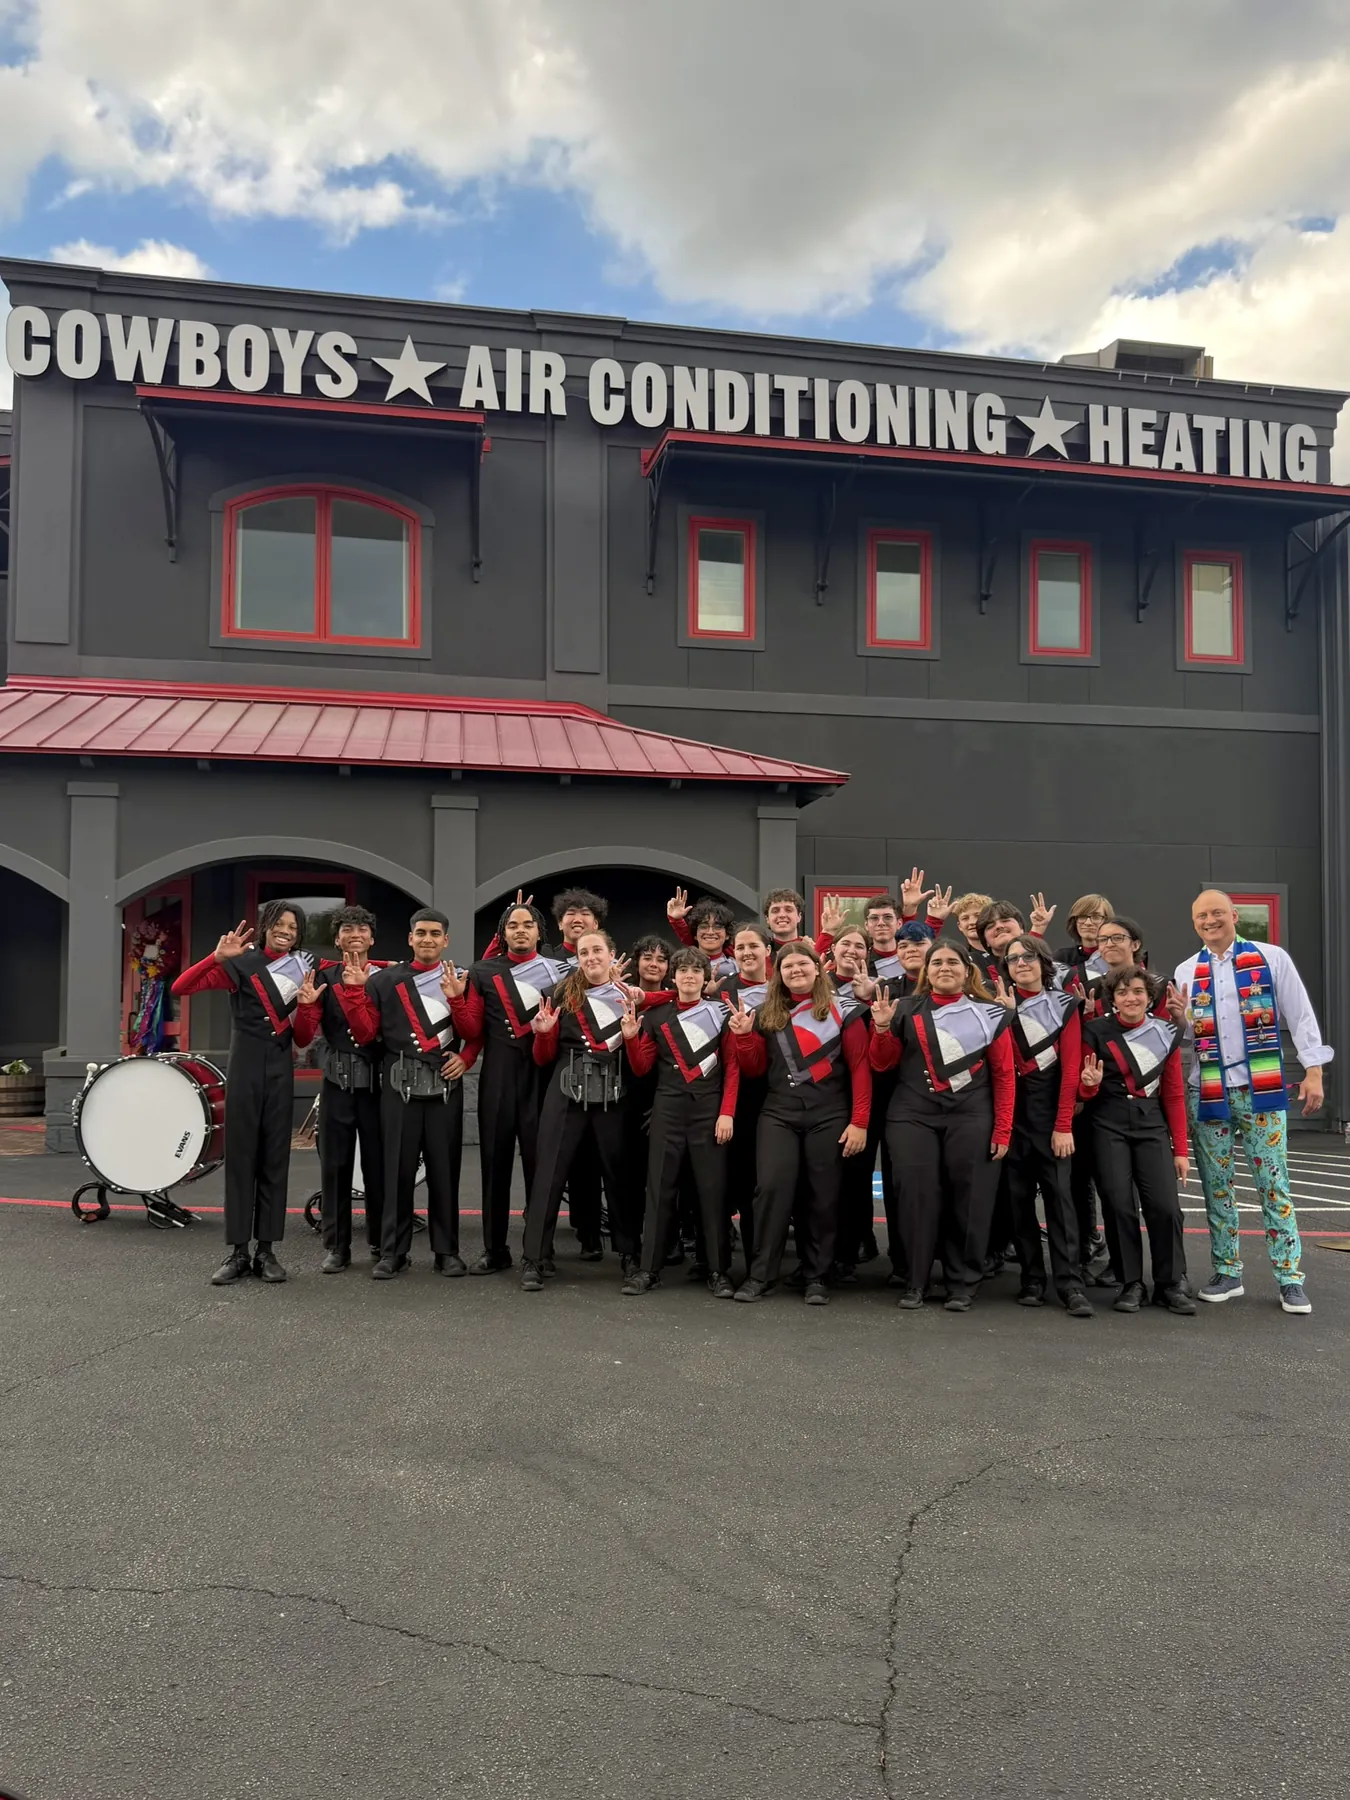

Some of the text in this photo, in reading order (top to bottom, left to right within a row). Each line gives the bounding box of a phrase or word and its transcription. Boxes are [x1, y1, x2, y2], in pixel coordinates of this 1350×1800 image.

[6, 306, 1317, 483] COWBOYS AIR CONDITIONING HEATING
[174, 1130, 191, 1159] EVANS
